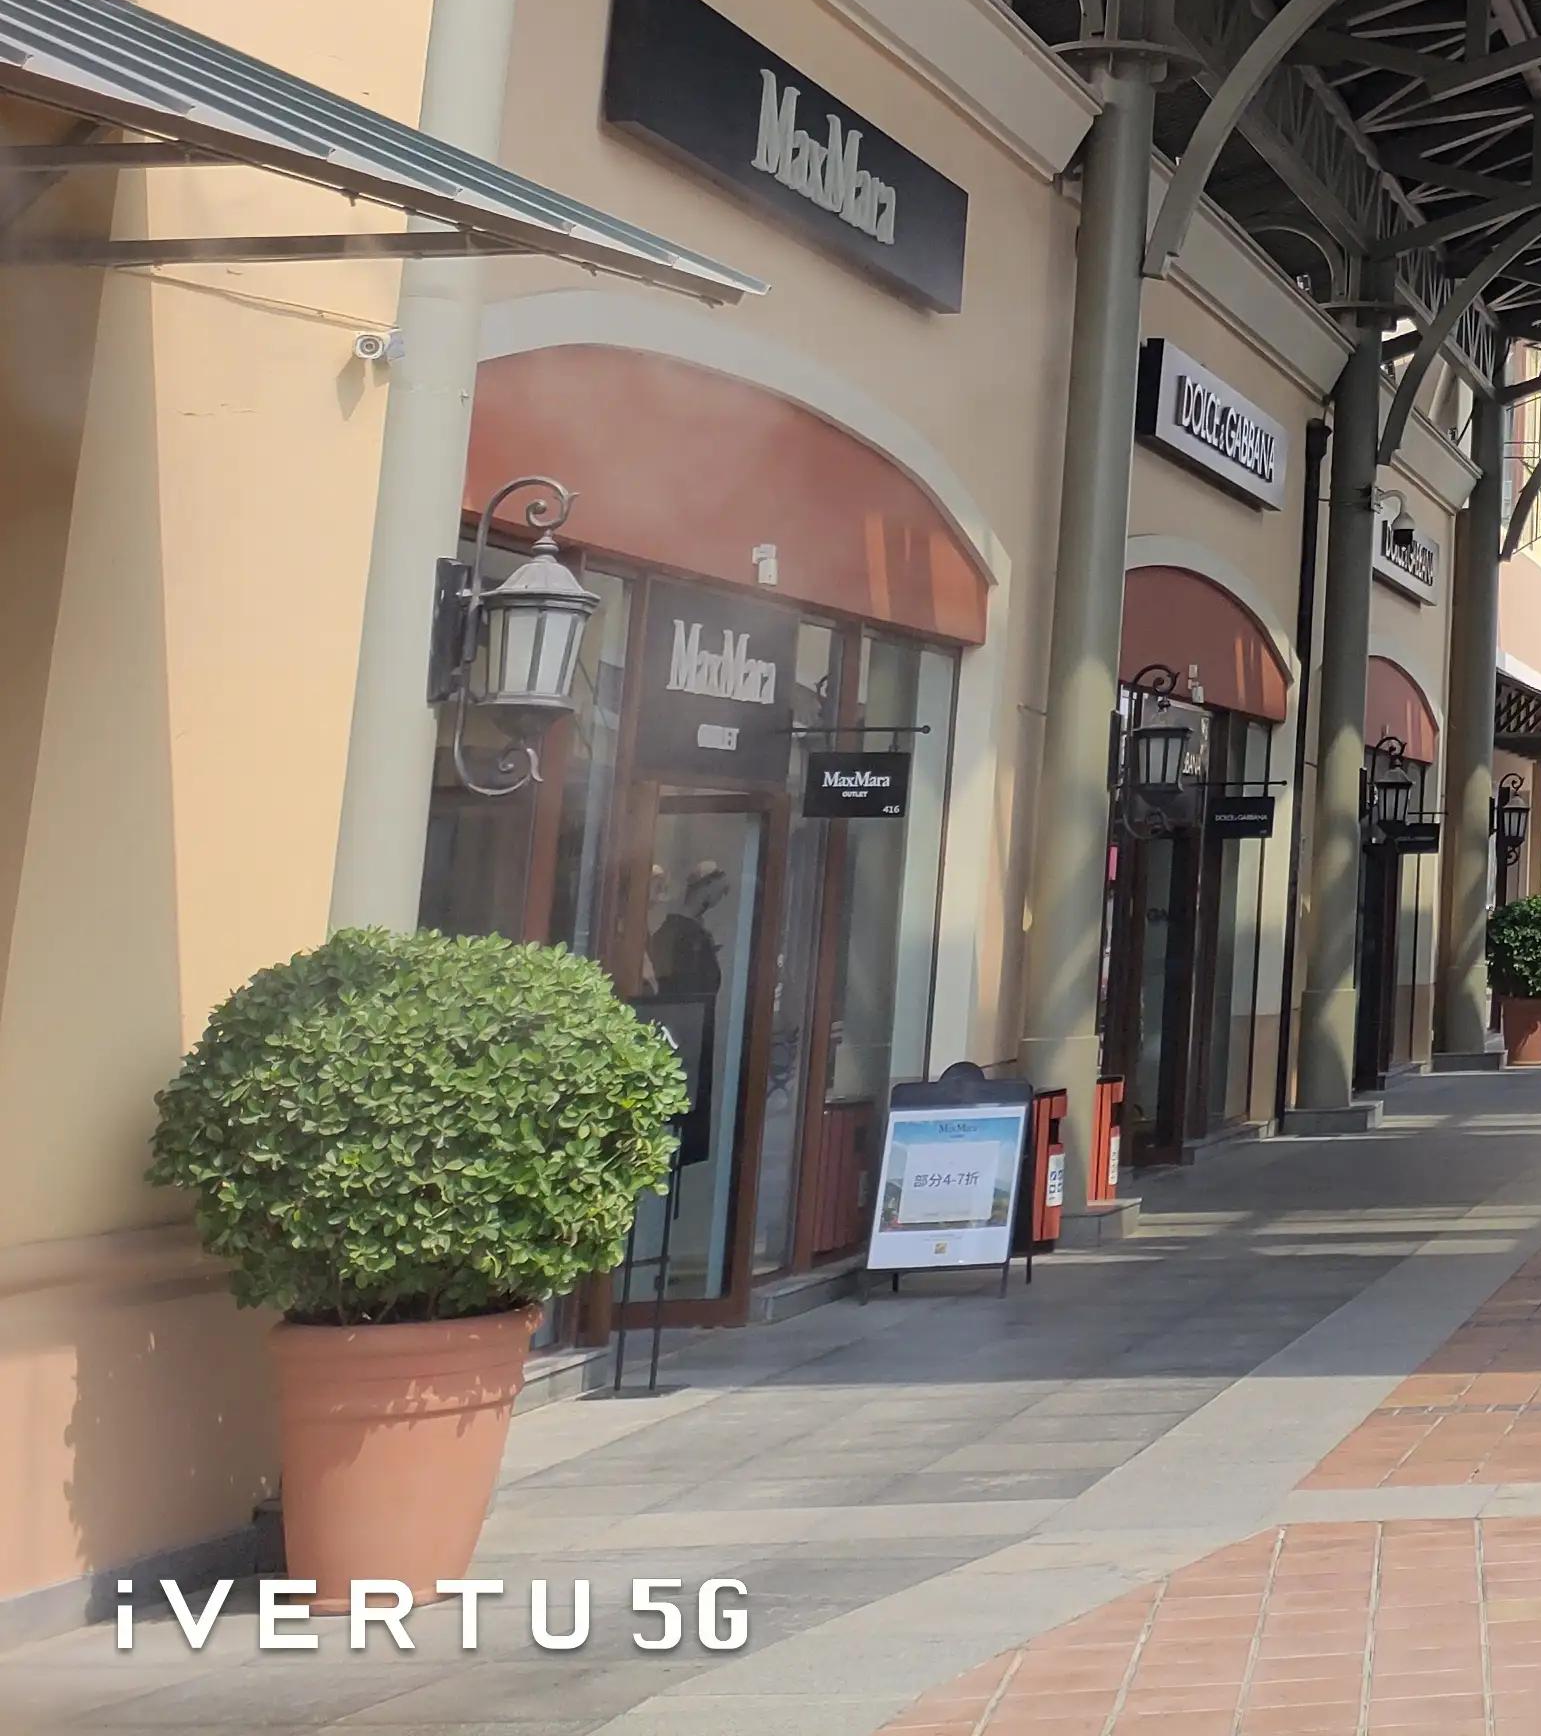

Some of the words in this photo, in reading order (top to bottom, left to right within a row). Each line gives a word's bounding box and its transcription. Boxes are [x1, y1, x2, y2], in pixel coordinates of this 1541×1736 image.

[751, 69, 896, 245] MaxMara
[666, 619, 777, 704] MaxMara
[822, 771, 891, 787] MaxMara
[882, 805, 900, 814] 416
[913, 1171, 981, 1188] 部分4-7折
